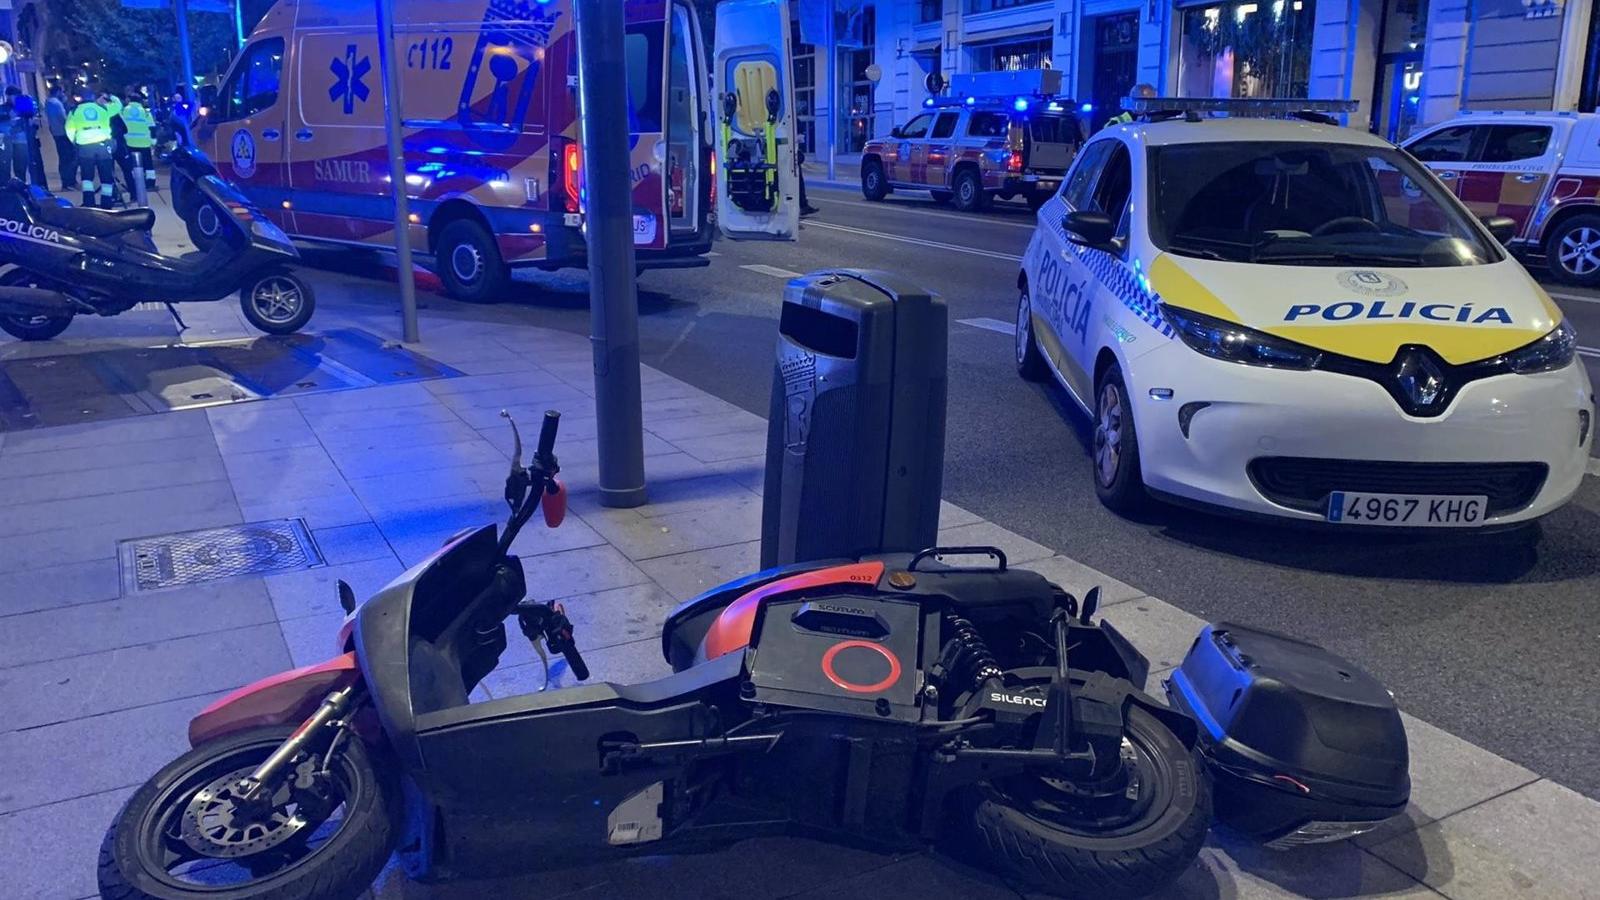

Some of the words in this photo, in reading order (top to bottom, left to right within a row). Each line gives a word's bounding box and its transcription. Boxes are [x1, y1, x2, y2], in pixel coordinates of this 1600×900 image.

[314, 160, 370, 183] SAMUR
[0, 217, 59, 243] POLICIA
[1284, 301, 1513, 324] POLICÍA
[1347, 497, 1419, 522] 4967
[1428, 500, 1479, 522] KHG
